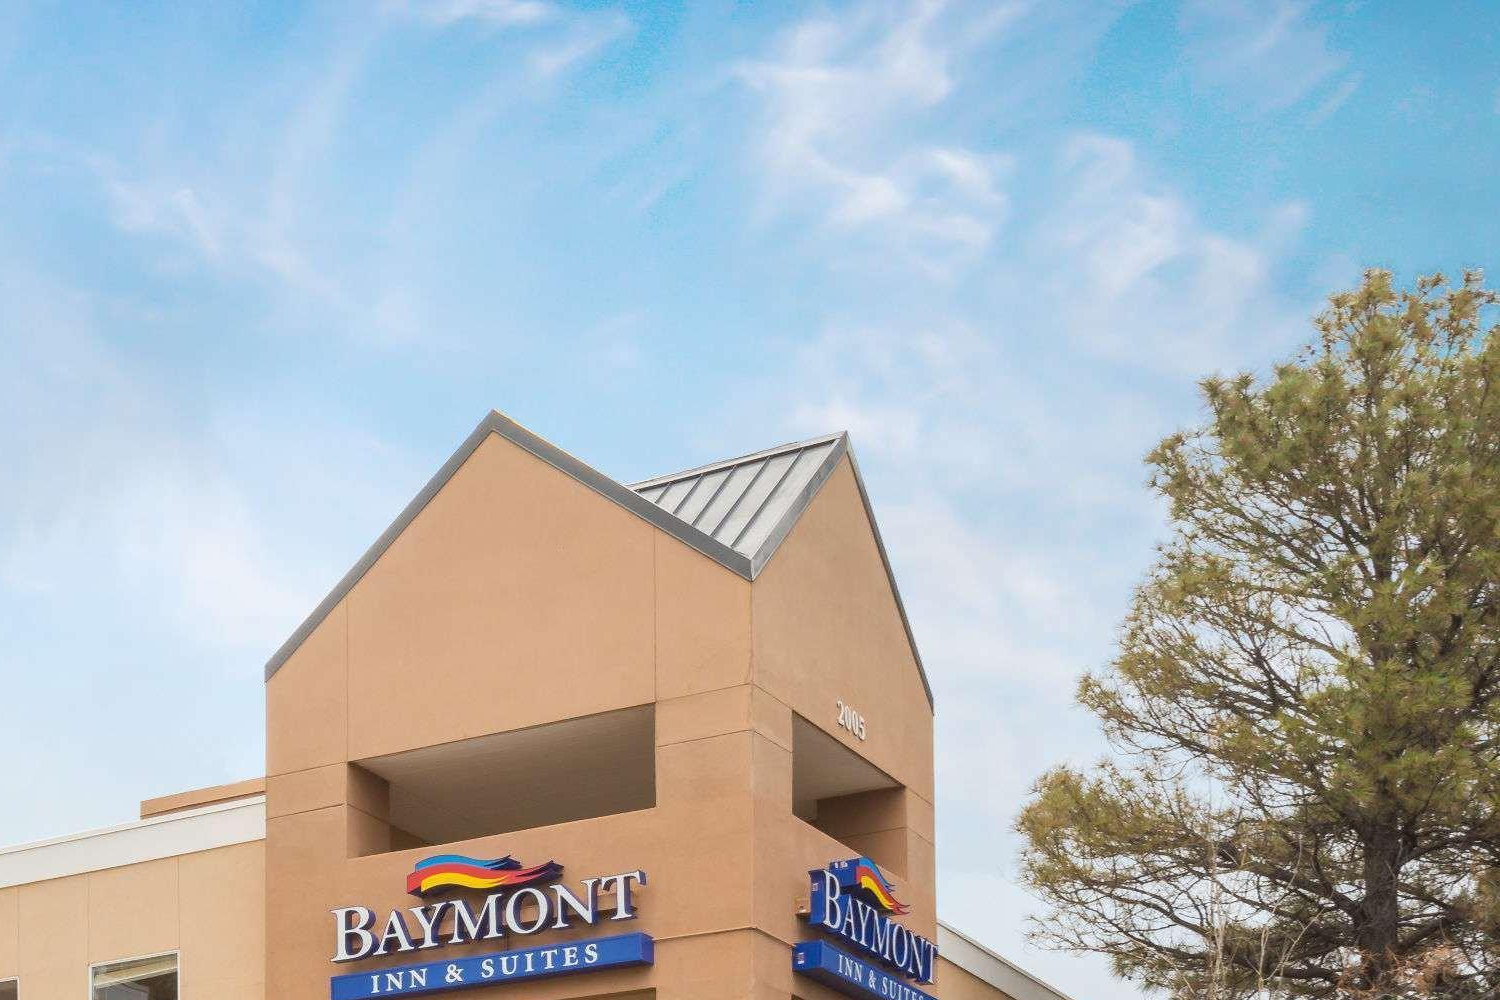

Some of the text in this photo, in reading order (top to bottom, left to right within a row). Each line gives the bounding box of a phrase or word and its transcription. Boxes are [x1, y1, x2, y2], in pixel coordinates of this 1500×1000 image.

[330, 869, 647, 963] BAYMONT
[822, 869, 938, 985] BAYMONT
[371, 943, 598, 994] INN & SUITES
[837, 953, 863, 984] INN
[868, 969, 877, 991] &
